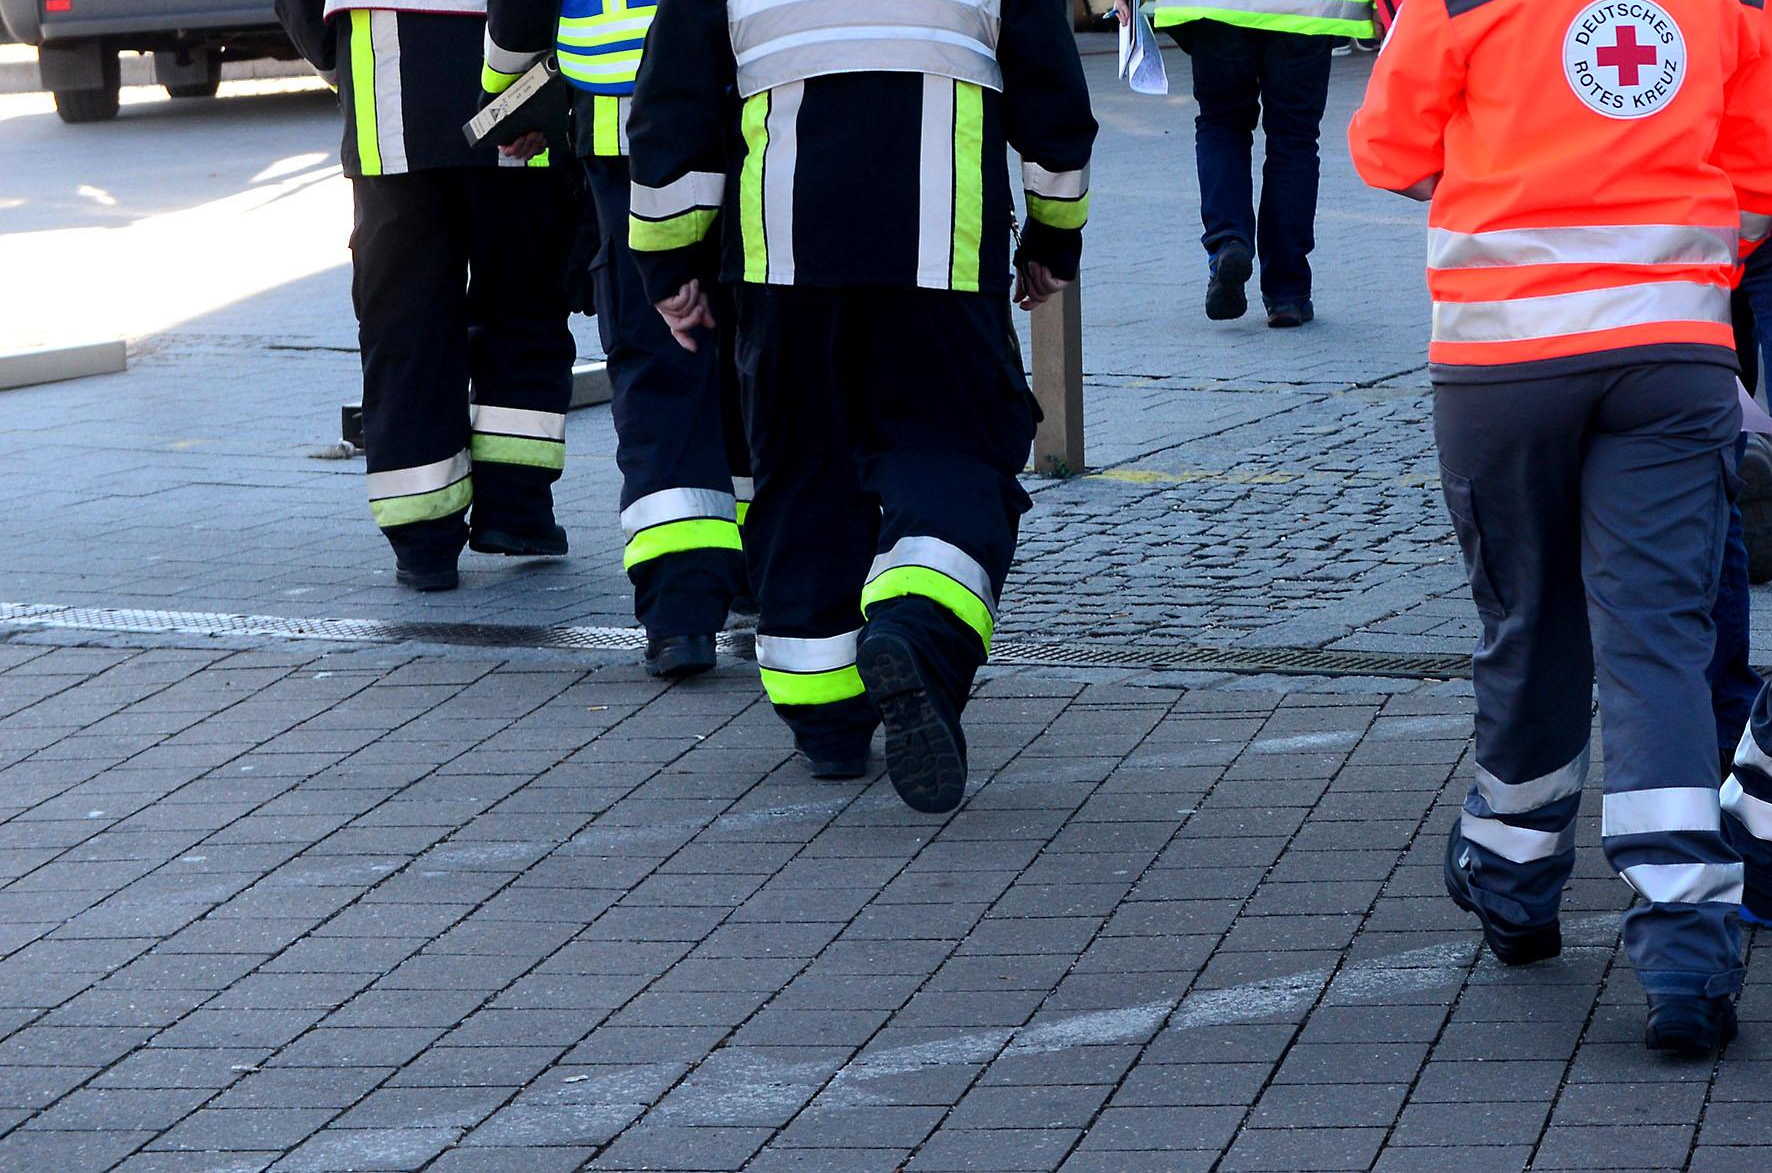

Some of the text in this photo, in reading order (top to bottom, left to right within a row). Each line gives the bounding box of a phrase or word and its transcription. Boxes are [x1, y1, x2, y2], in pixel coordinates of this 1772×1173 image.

[1575, 3, 1674, 46] DEUTSCHES
[1574, 58, 1677, 109] ROTES KREUZ
